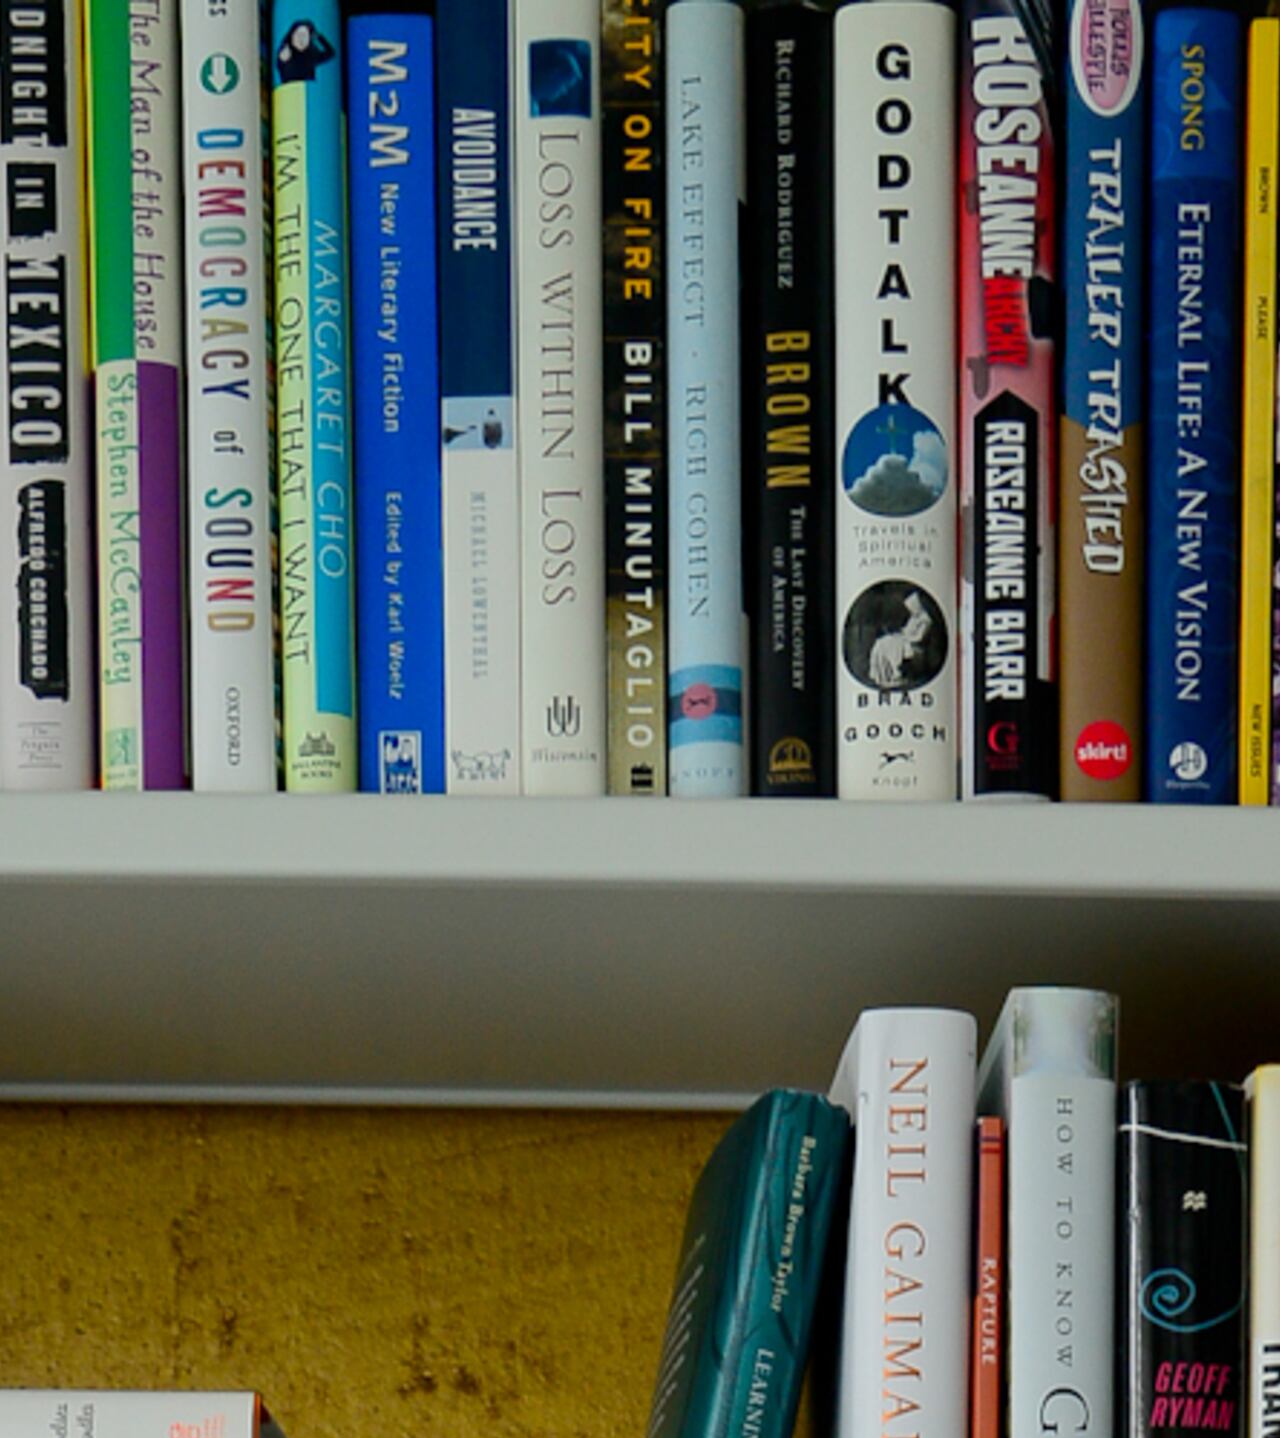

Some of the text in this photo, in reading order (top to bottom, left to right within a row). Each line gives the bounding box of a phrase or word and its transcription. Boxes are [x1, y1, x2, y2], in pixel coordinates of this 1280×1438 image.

[1179, 45, 1204, 152] SPONG
[451, 108, 497, 252] AVOIDANCE
[378, 183, 400, 433] New Literary Fiction
[537, 272, 575, 459] WITHIN
[986, 420, 1025, 702] ROSEANNE BARR
[223, 688, 240, 766] OXFORD
[889, 1057, 929, 1198] NEIL
[1150, 1398, 1236, 1430] RYMAN
[1154, 1362, 1231, 1394] GEOFF
